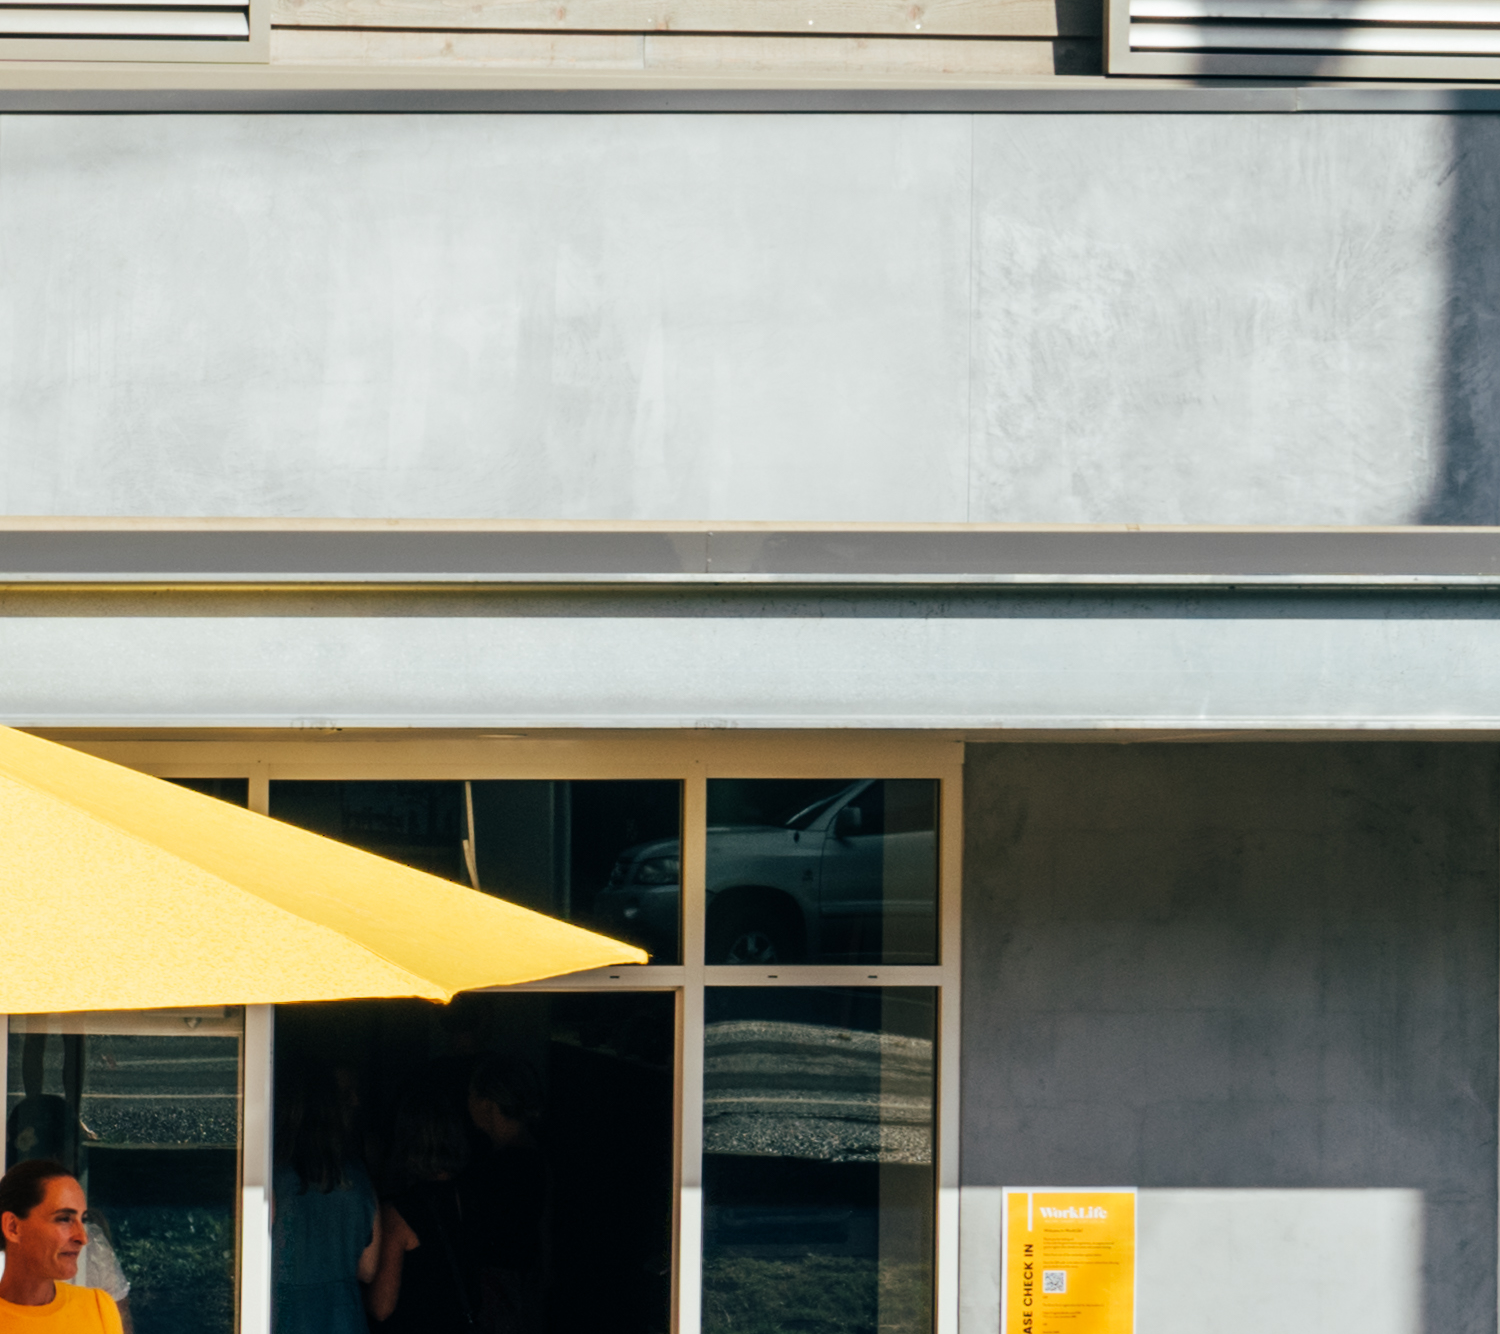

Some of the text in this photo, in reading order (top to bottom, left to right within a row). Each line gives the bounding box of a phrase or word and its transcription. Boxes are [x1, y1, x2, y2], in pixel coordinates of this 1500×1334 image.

[1039, 1206, 1108, 1219] WorkLife
[1024, 1244, 1034, 1257] IN
[1023, 1262, 1034, 1306] CHECK
